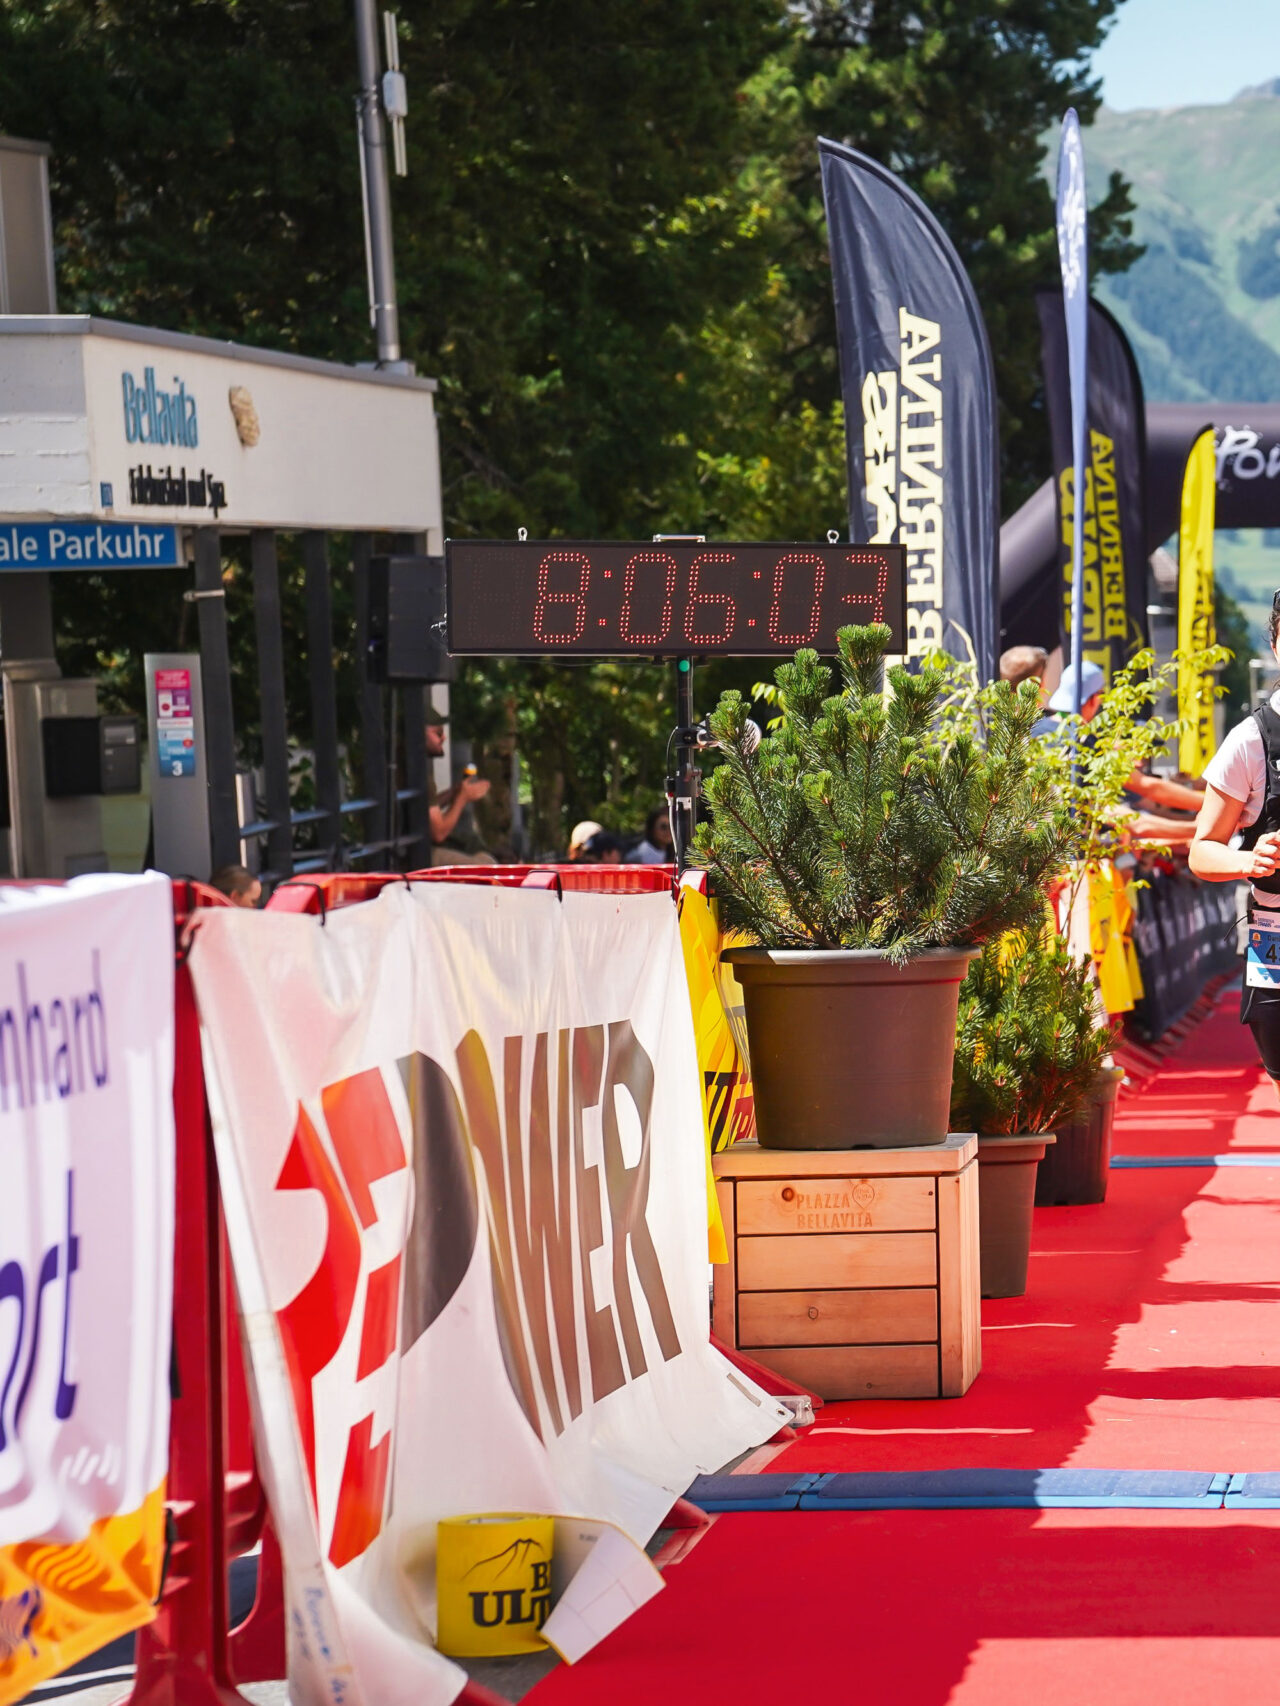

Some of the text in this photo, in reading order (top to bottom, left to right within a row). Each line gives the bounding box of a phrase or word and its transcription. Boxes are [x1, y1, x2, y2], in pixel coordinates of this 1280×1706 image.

[122, 367, 198, 448] Bellavita
[0, 525, 165, 561] ale Parkuhr
[533, 552, 888, 645] 8:06:03
[796, 1212, 873, 1229] BELLAVITA
